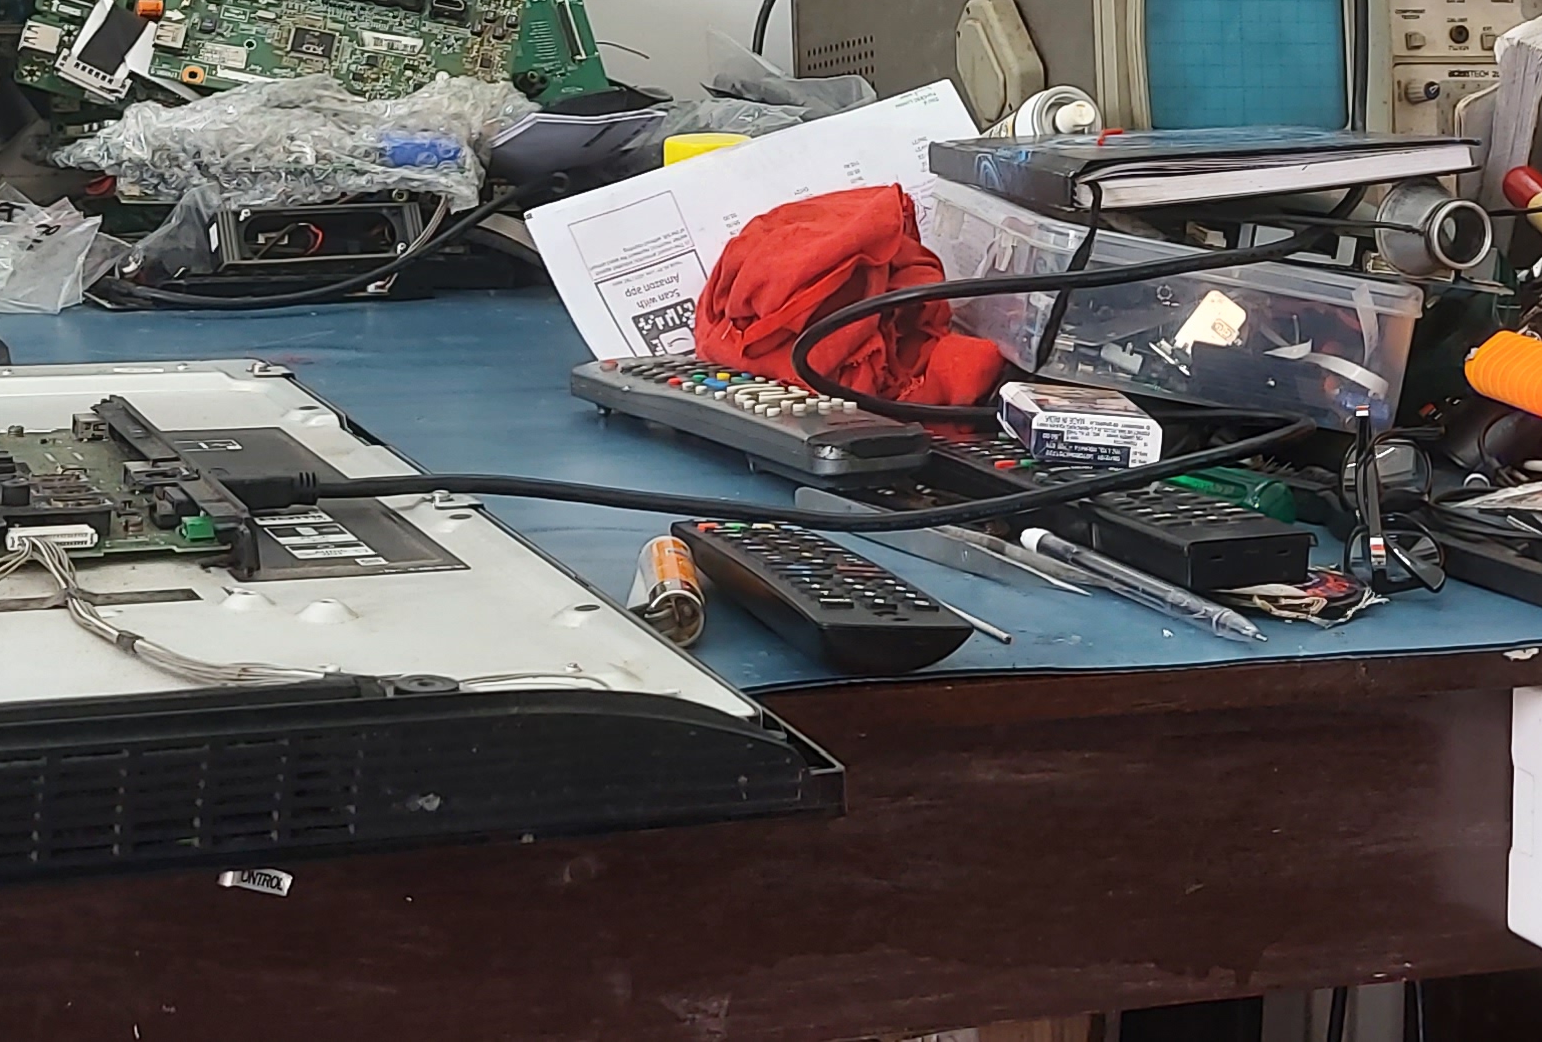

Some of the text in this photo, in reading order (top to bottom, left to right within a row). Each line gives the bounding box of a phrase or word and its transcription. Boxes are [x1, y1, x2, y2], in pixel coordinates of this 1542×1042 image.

[624, 285, 643, 298] app
[643, 272, 680, 292] Amazon
[636, 288, 681, 309] Scan with
